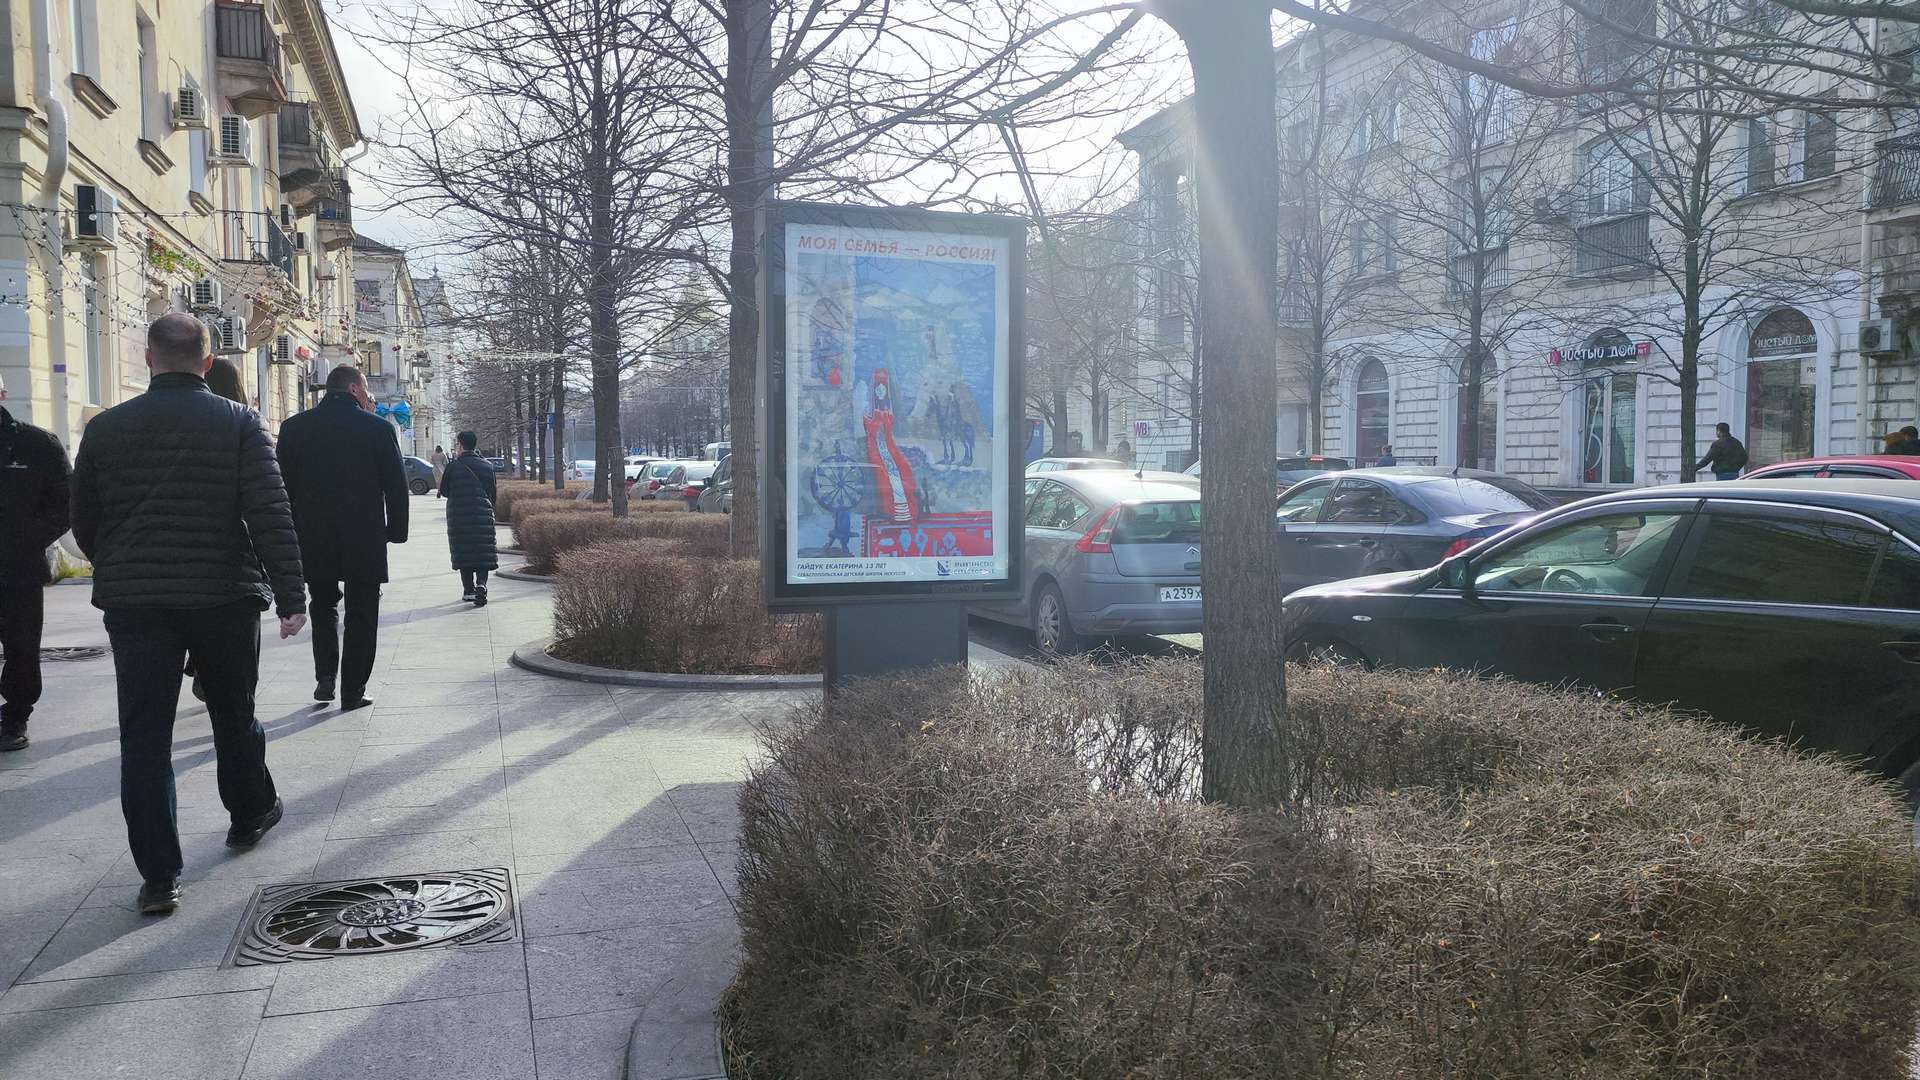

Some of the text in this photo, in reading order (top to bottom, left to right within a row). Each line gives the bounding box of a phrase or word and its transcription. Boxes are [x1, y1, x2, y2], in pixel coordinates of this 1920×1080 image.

[798, 235, 836, 250] МОЯ
[844, 238, 898, 253] СЕМЬЯ
[925, 244, 995, 261] РОССИЯ!
[798, 562, 823, 570] ГАЙДУК
